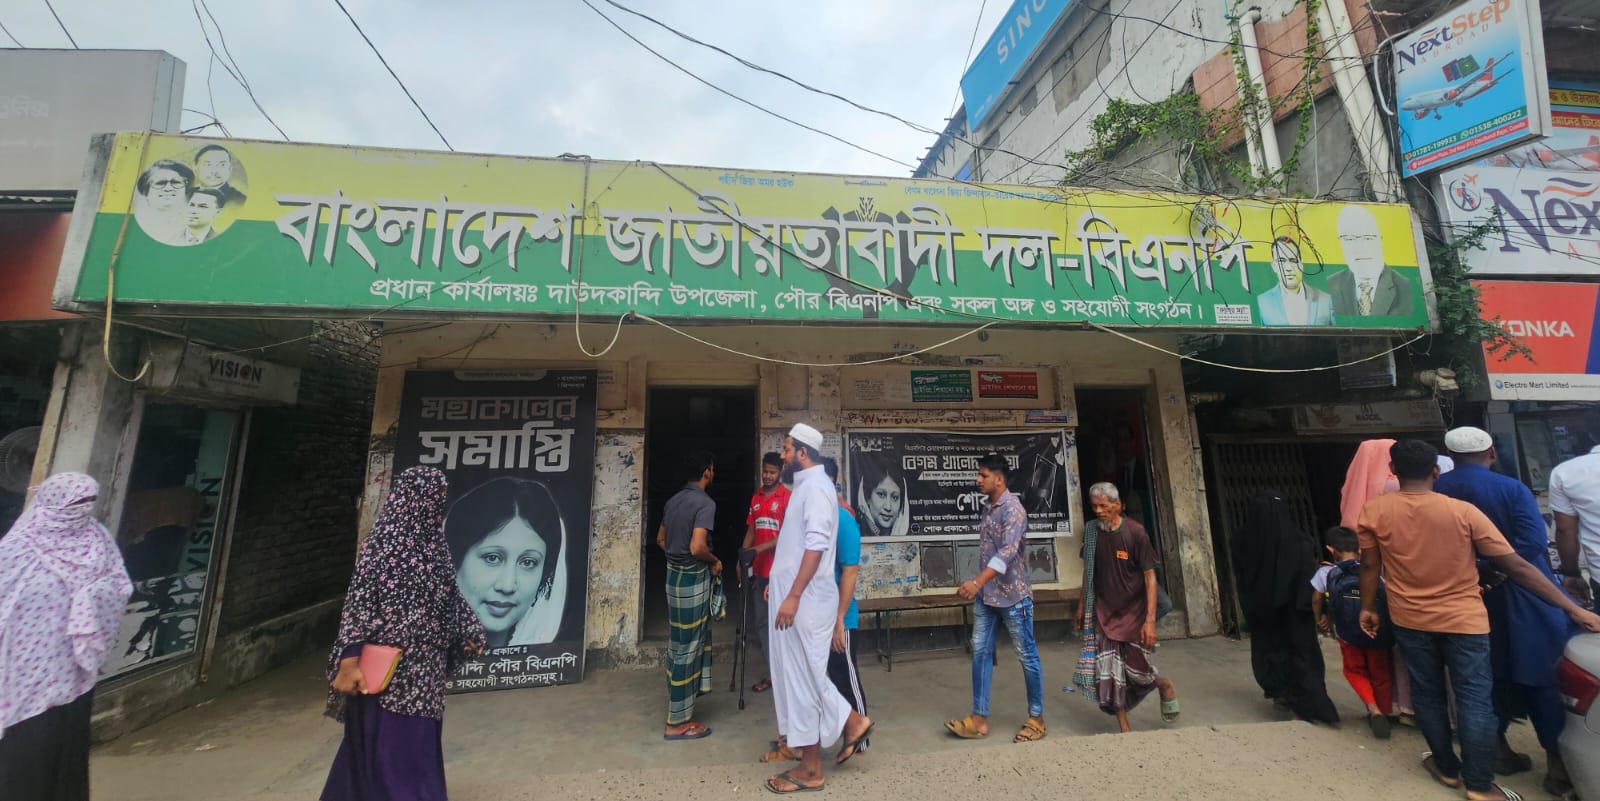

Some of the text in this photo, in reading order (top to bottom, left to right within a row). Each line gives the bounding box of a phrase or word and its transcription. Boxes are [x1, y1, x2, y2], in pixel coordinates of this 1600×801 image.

[274, 187, 1253, 294] বাংলাদেশ জাতীয়তাবাদী দল-বিএনপি
[370, 278, 434, 300] প্রধান
[547, 279, 664, 305] দাউদকান্দি
[775, 284, 820, 310] পৌর
[828, 287, 898, 313] বিএনপি
[906, 295, 942, 313] এবং
[949, 295, 996, 315] সকল
[1002, 297, 1034, 316] অঙ্গ
[1042, 299, 1056, 316] ও
[1062, 295, 1130, 318] সহযোগী
[1496, 320, 1576, 337] ONKA
[421, 396, 579, 420] মহাকালের
[418, 420, 575, 473] সমাপ্তি
[903, 455, 938, 470] বেগম
[489, 658, 522, 674] পৌর
[526, 653, 577, 672] বিএনপি
[457, 675, 498, 690] সহযোগী
